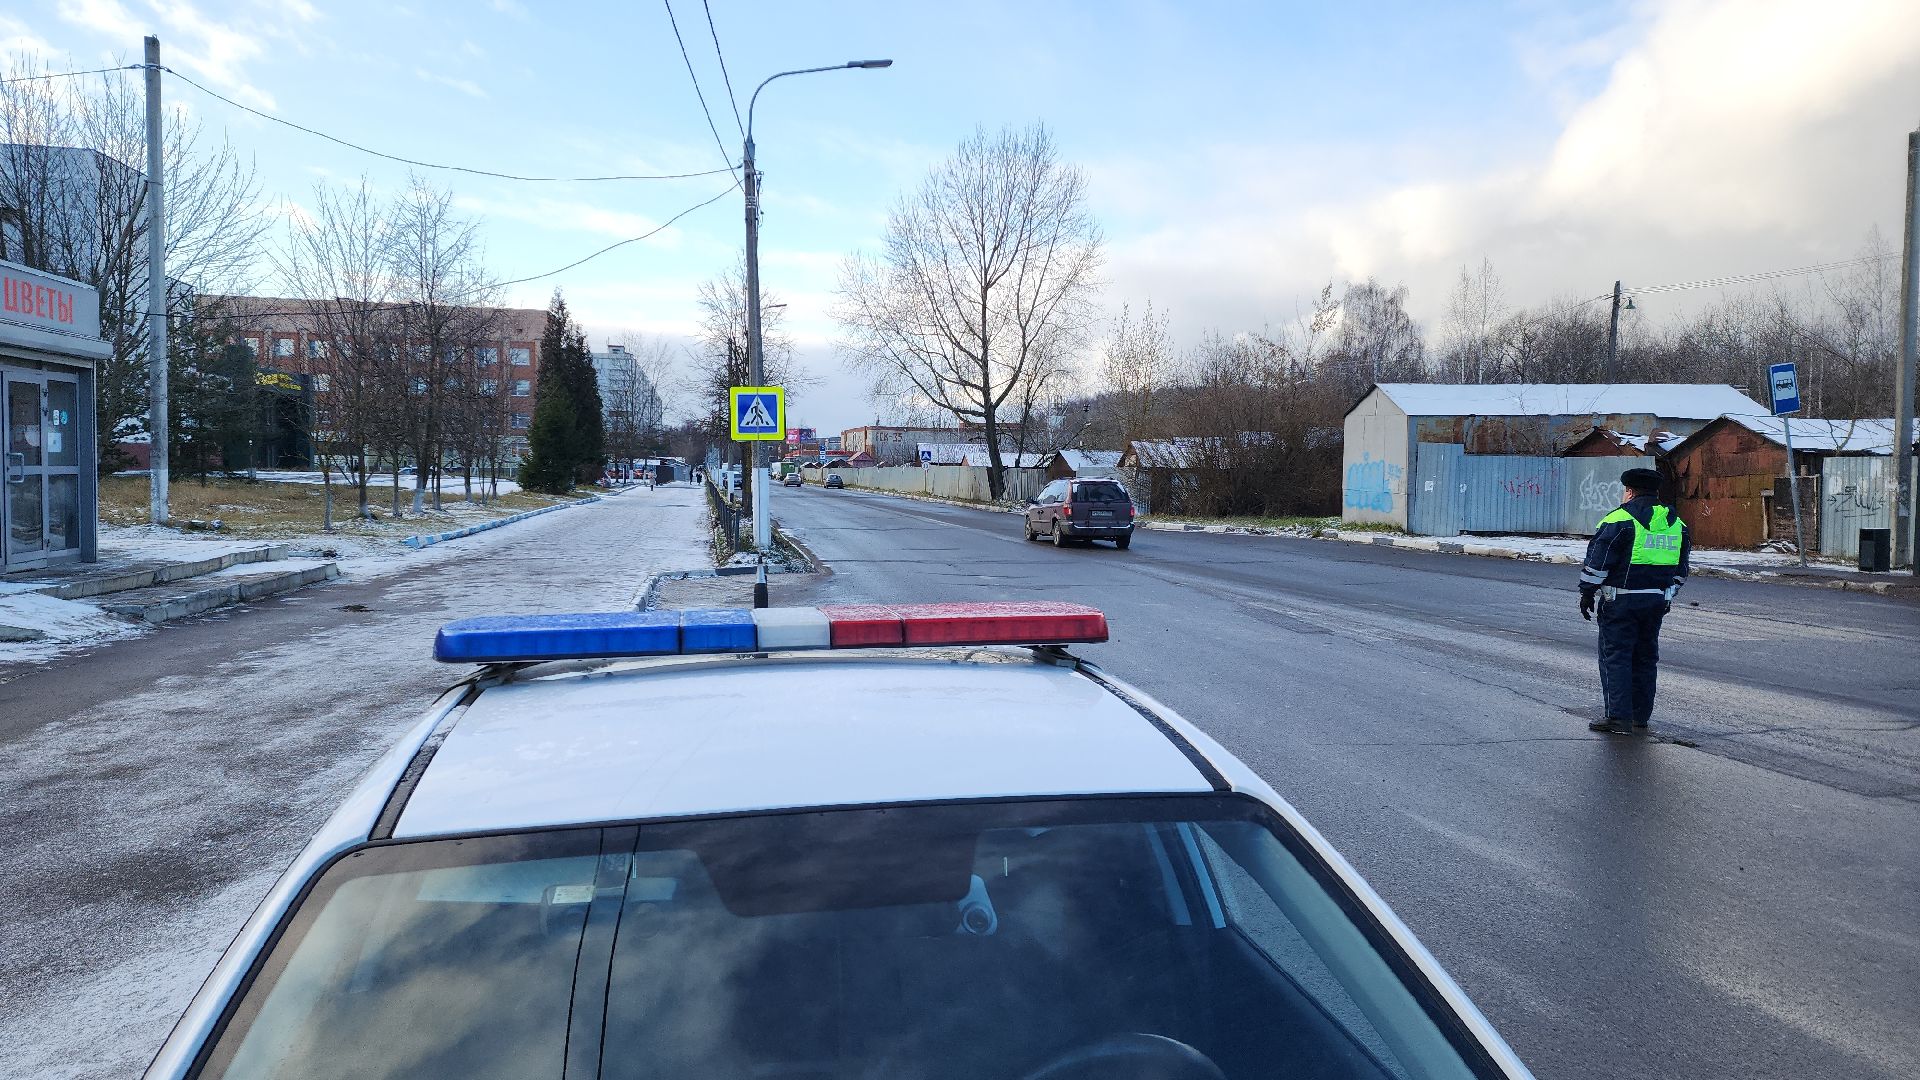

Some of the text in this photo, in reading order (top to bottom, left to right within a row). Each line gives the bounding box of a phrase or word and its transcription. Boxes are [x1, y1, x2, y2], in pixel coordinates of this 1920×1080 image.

[4, 277, 73, 324] ЦВЕТЫ
[876, 432, 903, 442] ГСК-35
[1643, 533, 1679, 551] ДПС
